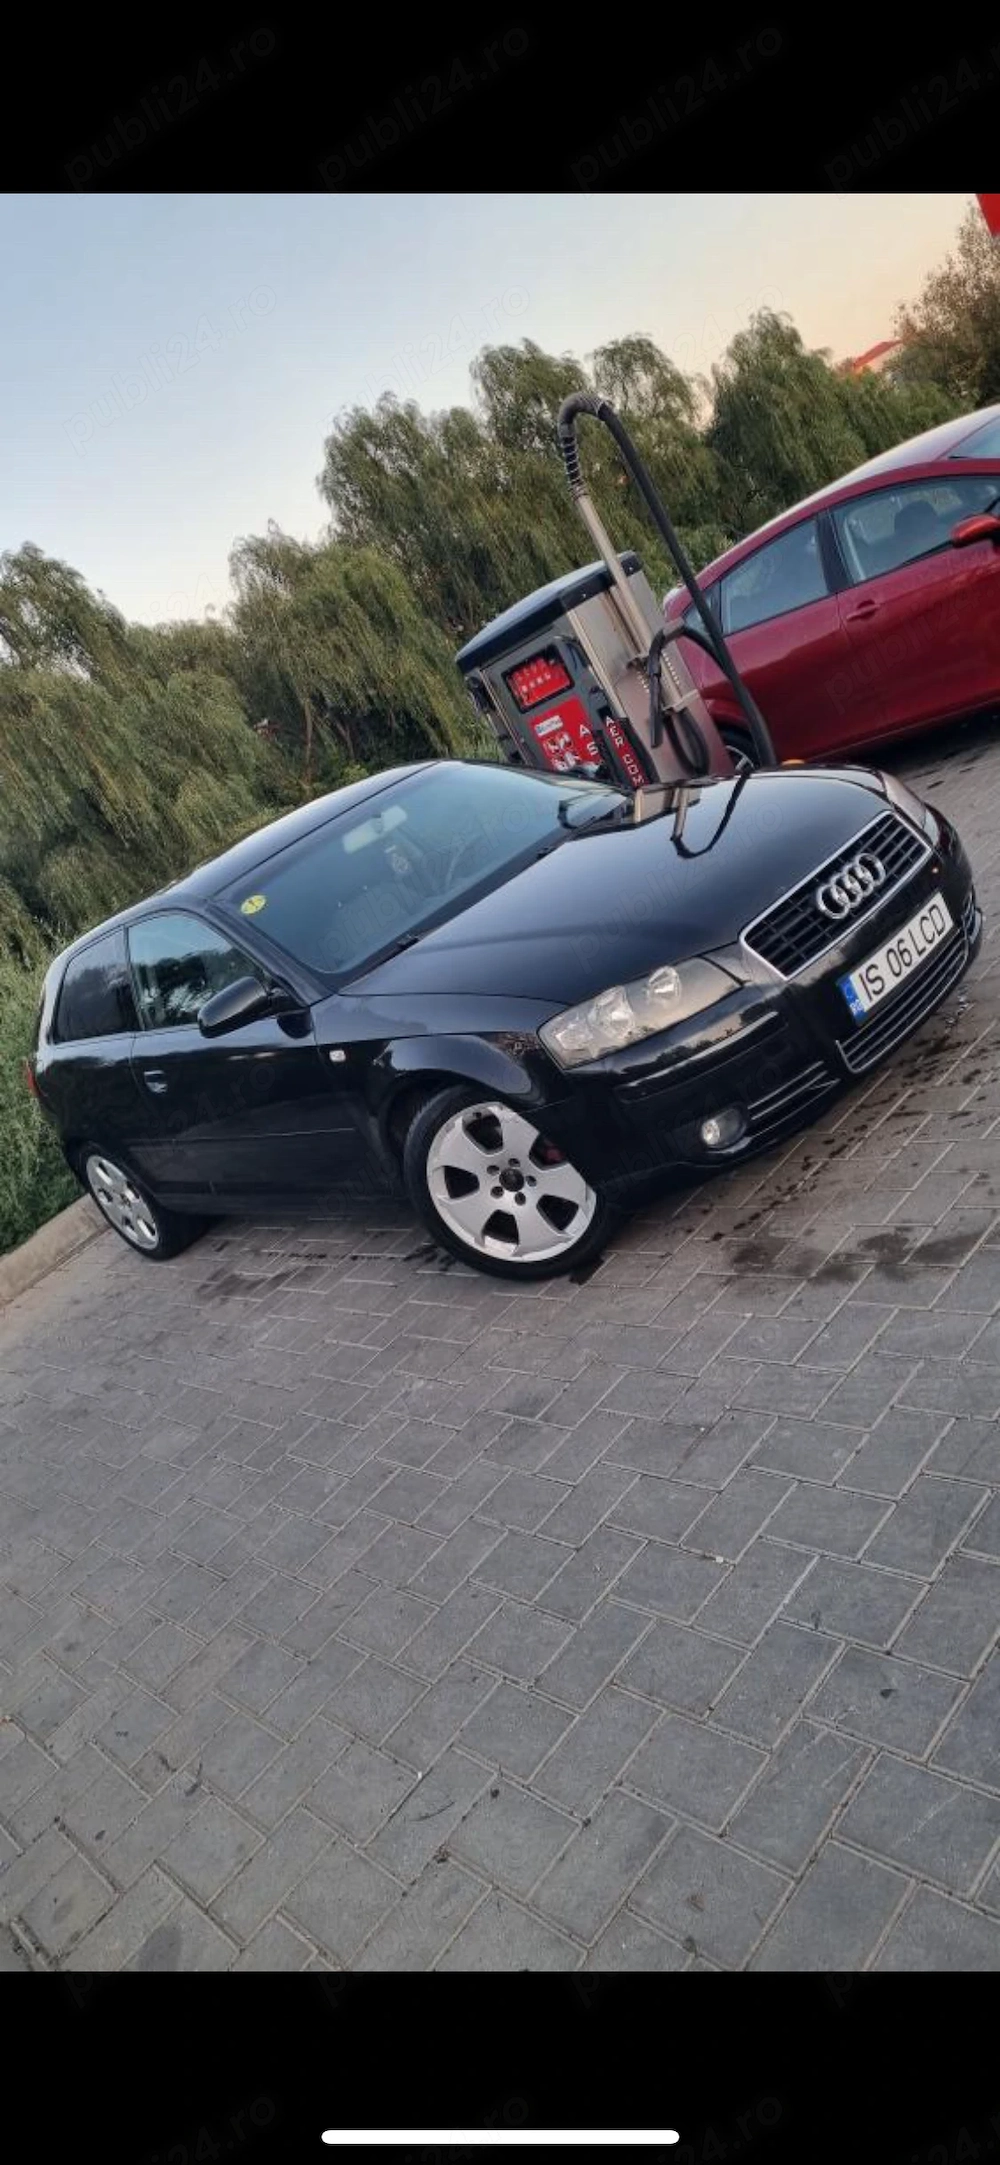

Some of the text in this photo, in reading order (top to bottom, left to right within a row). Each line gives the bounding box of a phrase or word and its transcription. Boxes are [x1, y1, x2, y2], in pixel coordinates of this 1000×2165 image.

[858, 903, 946, 1003] IS 06 LCD
